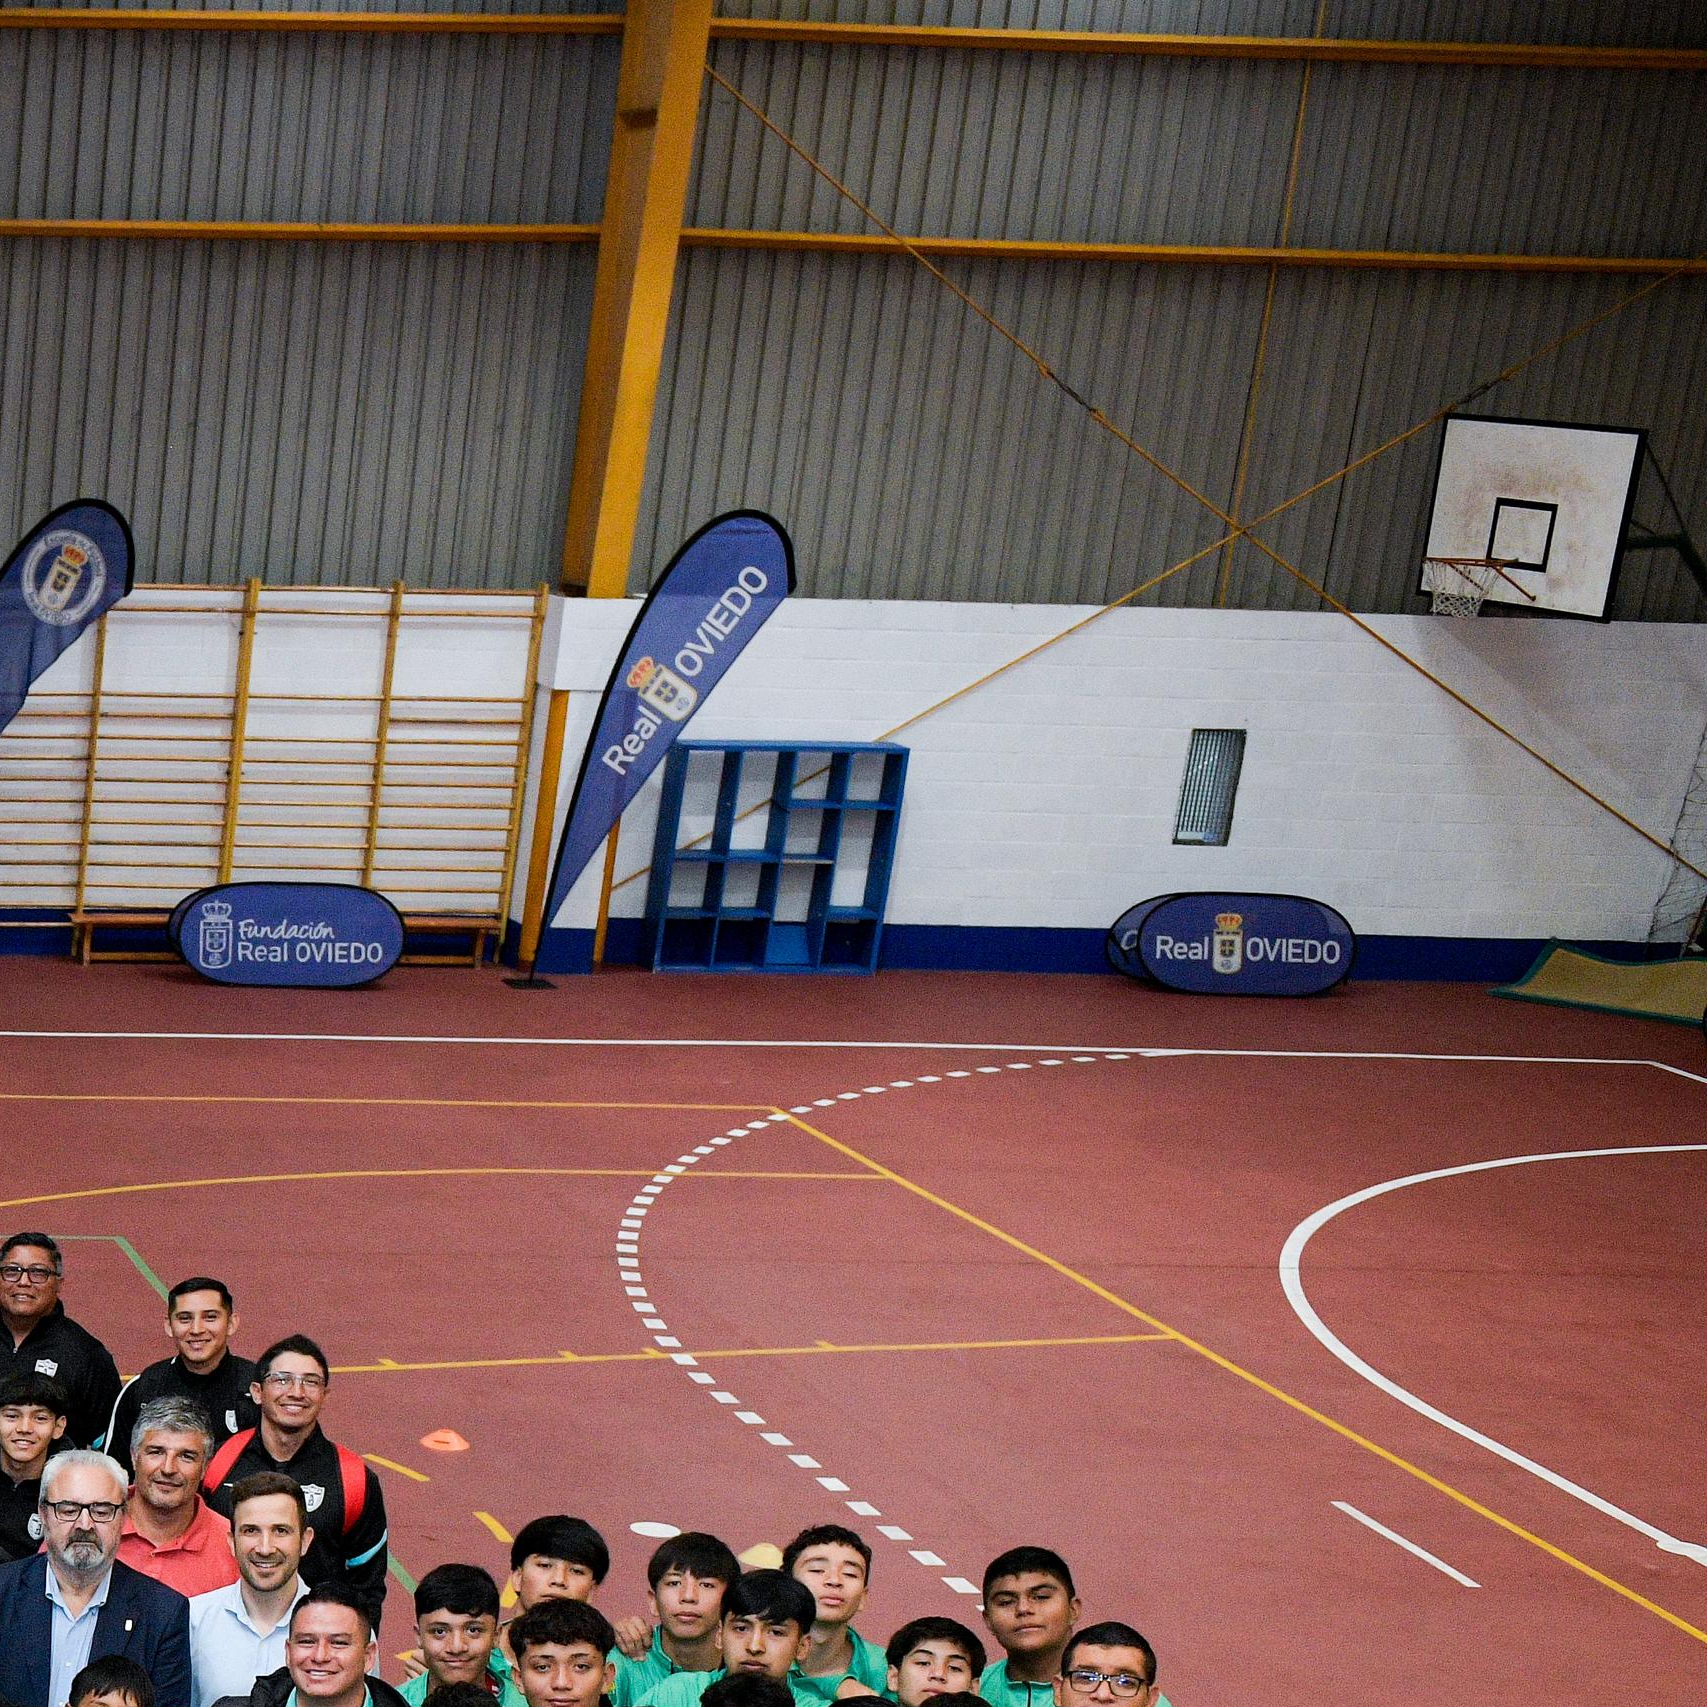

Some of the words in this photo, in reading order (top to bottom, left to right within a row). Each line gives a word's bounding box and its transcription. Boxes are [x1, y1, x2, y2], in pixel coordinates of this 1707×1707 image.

[601, 705, 662, 776] Real
[674, 565, 768, 677] OVIEDO
[238, 918, 335, 940] Fundación
[238, 942, 288, 962] Real
[295, 942, 383, 964] OVIEDO
[1155, 935, 1209, 960] Real
[1245, 937, 1341, 965] OVIEDO
